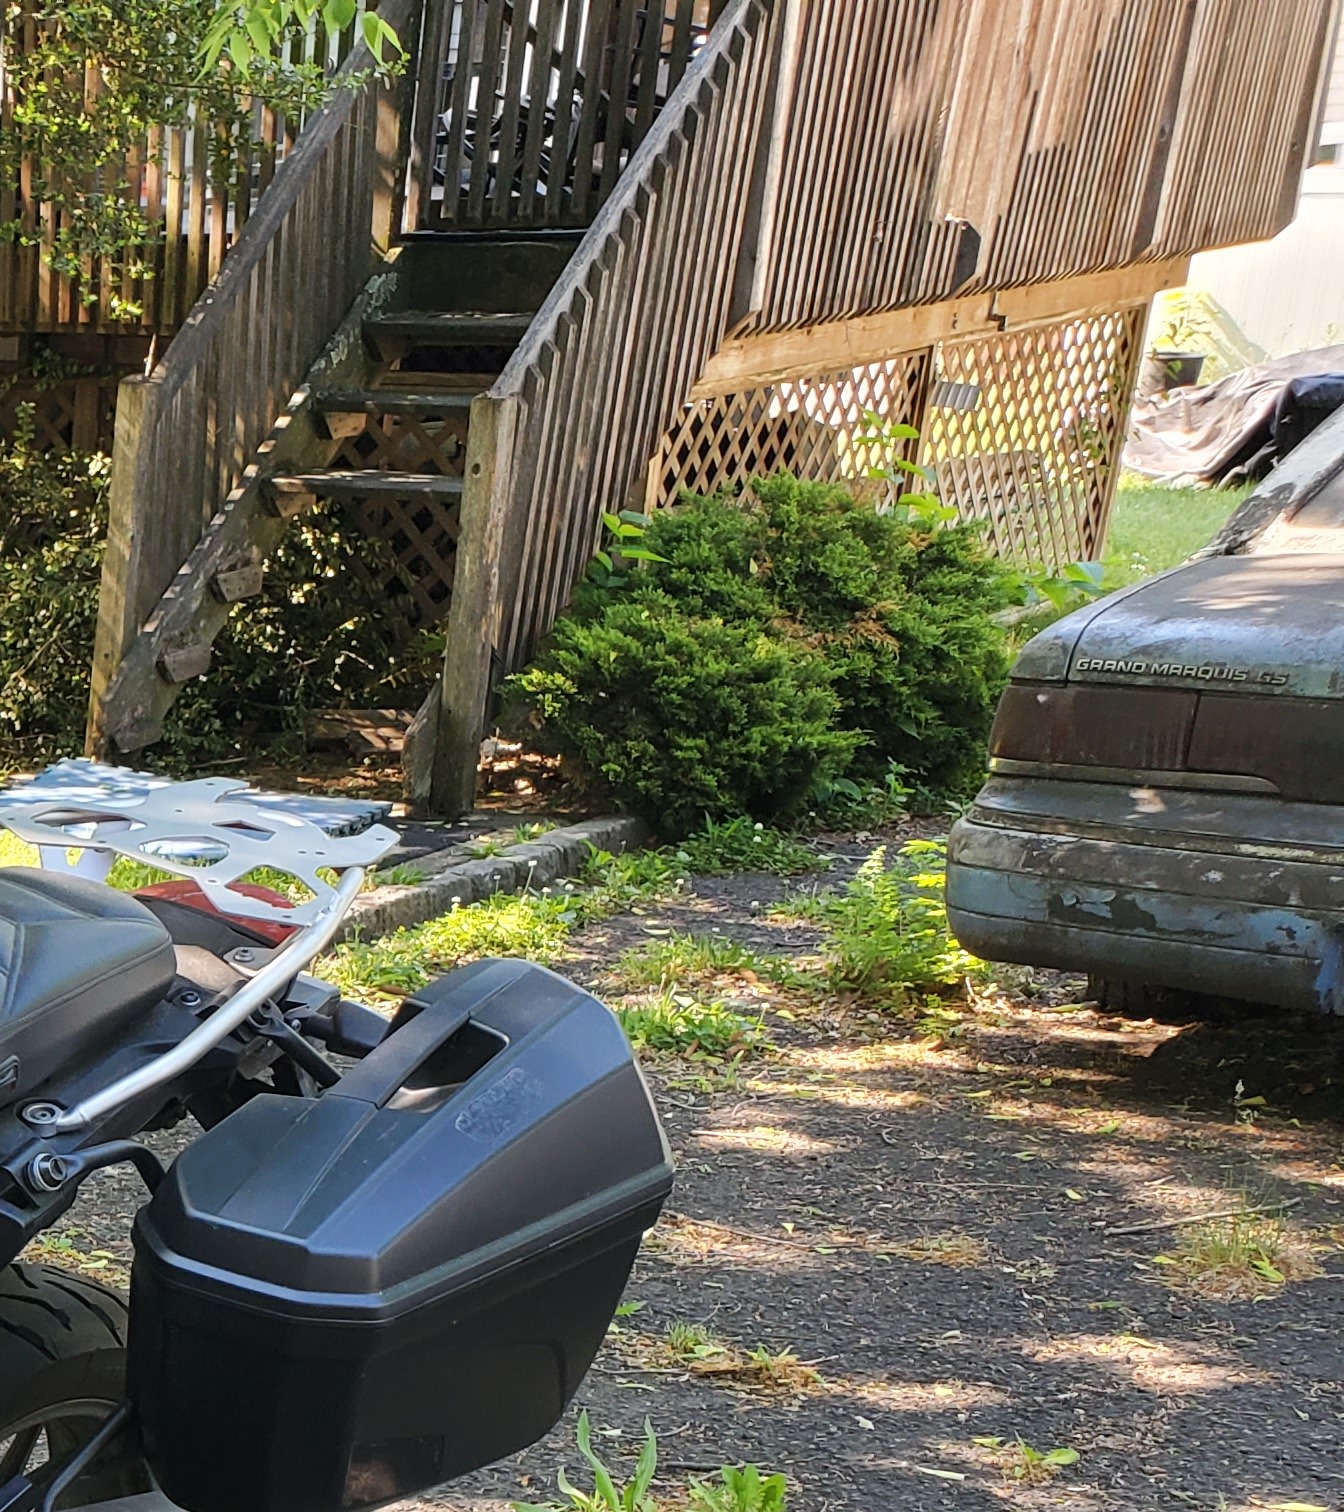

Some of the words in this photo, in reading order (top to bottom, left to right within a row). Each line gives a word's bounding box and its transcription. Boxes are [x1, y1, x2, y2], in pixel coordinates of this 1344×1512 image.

[1075, 658, 1146, 674] GRAND
[1150, 662, 1248, 681] MARQUIS
[1255, 670, 1290, 685] GS
